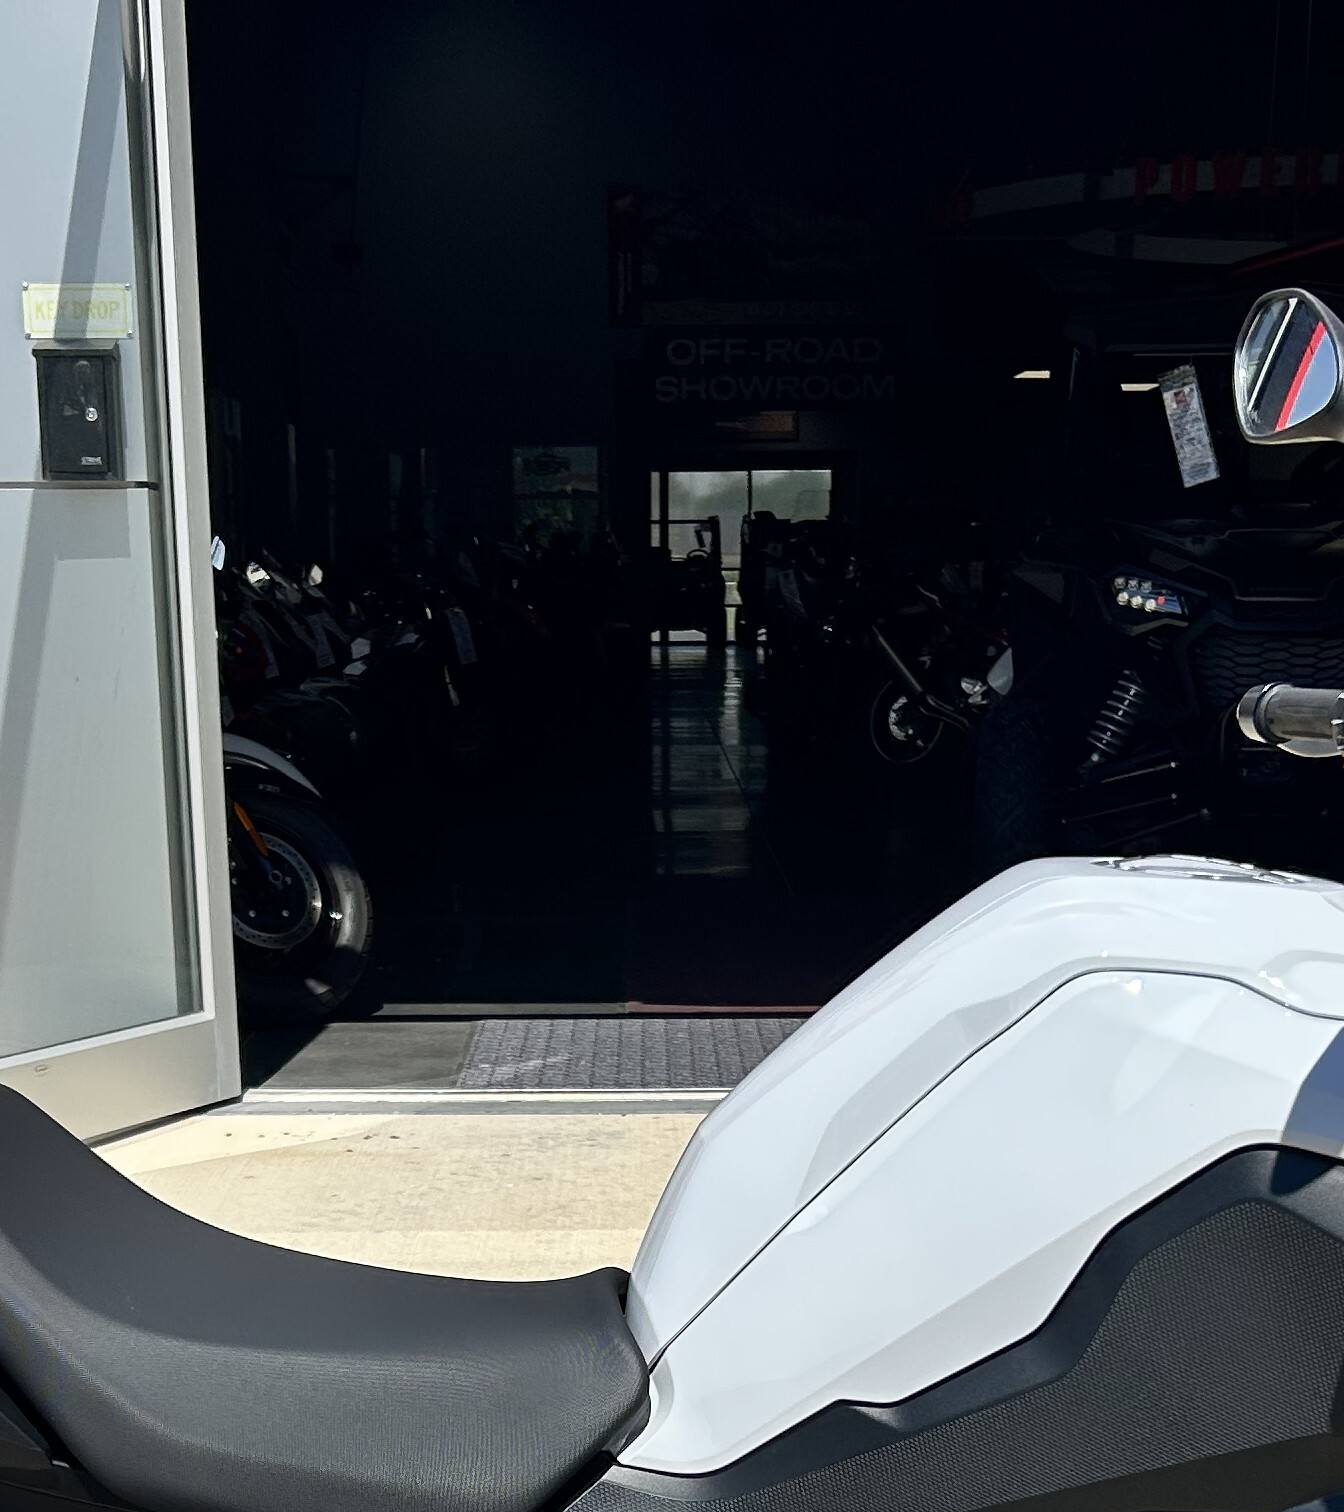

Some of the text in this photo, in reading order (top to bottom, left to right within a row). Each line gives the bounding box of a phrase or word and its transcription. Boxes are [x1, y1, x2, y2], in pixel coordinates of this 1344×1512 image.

[34, 299, 121, 320] KEY DROP
[665, 336, 884, 366] OFF-ROAD
[654, 373, 897, 403] SHOWROOM
